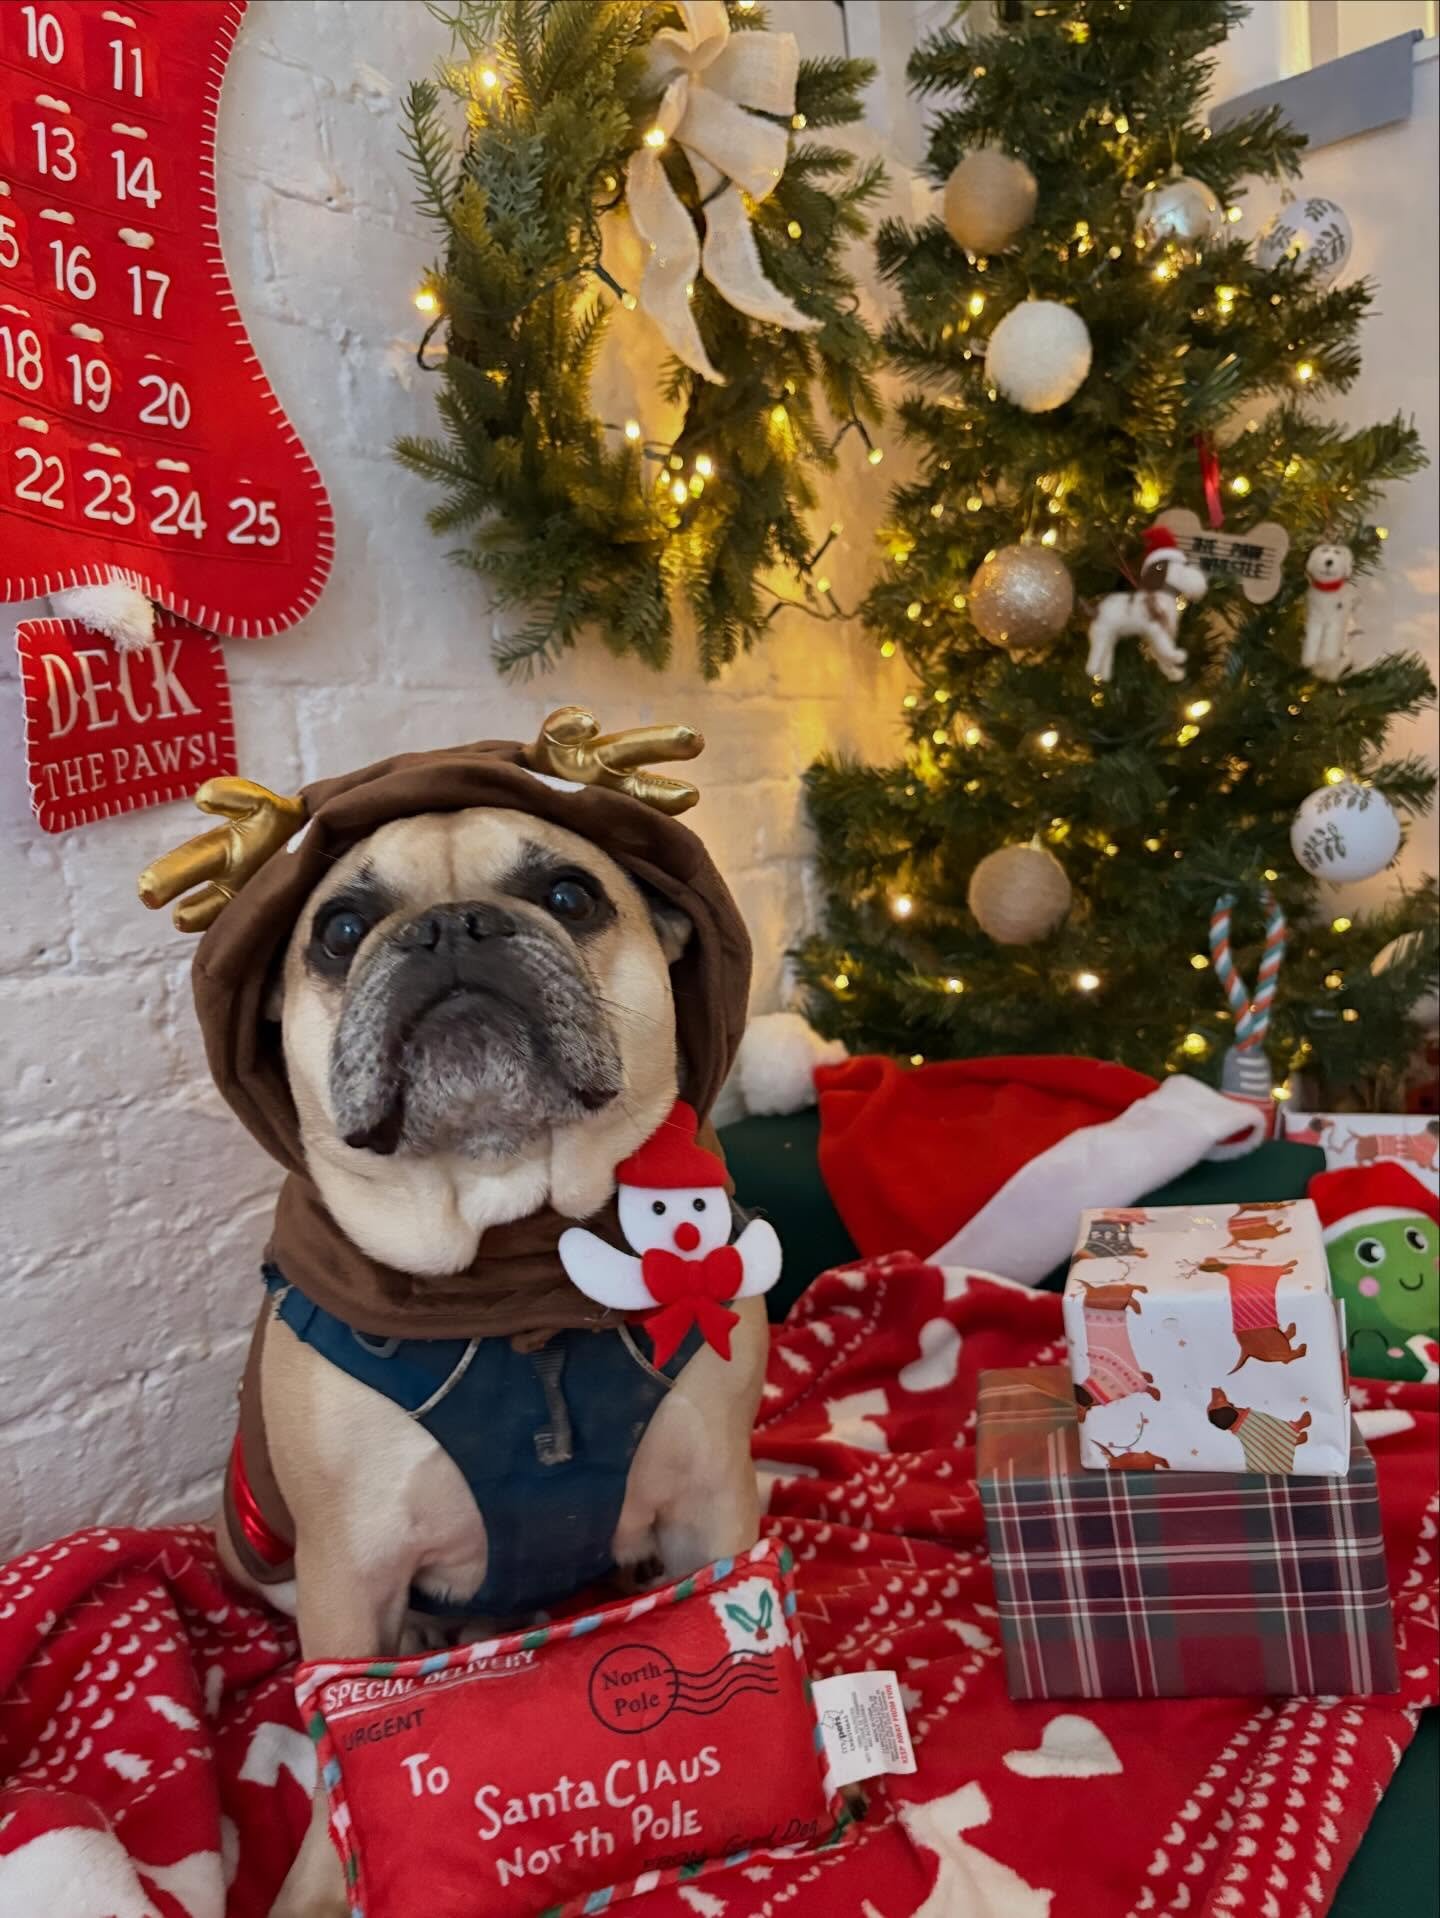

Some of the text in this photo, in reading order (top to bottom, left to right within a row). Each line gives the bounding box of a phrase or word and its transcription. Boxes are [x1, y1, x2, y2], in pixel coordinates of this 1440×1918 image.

[21, 6, 64, 64] 10
[109, 40, 143, 97] 11
[31, 122, 77, 181] 13
[111, 150, 162, 208] 14
[49, 240, 96, 300] 16
[127, 265, 170, 319] 17
[0, 326, 43, 390] 18
[66, 354, 111, 413] 19
[138, 375, 191, 430] 20
[15, 447, 64, 510] 22
[83, 469, 136, 525] 23
[150, 485, 207, 540] 24
[227, 497, 280, 547] 25
[40, 639, 202, 739] DECK
[43, 731, 218, 802] THE PAWS!
[322, 1677, 417, 1713] SPECIAL
[602, 1662, 662, 1717] North Pole
[343, 1709, 425, 1751] URGENT
[401, 1753, 449, 1797] To
[474, 1775, 600, 1841] Santa
[496, 1826, 614, 1887] North
